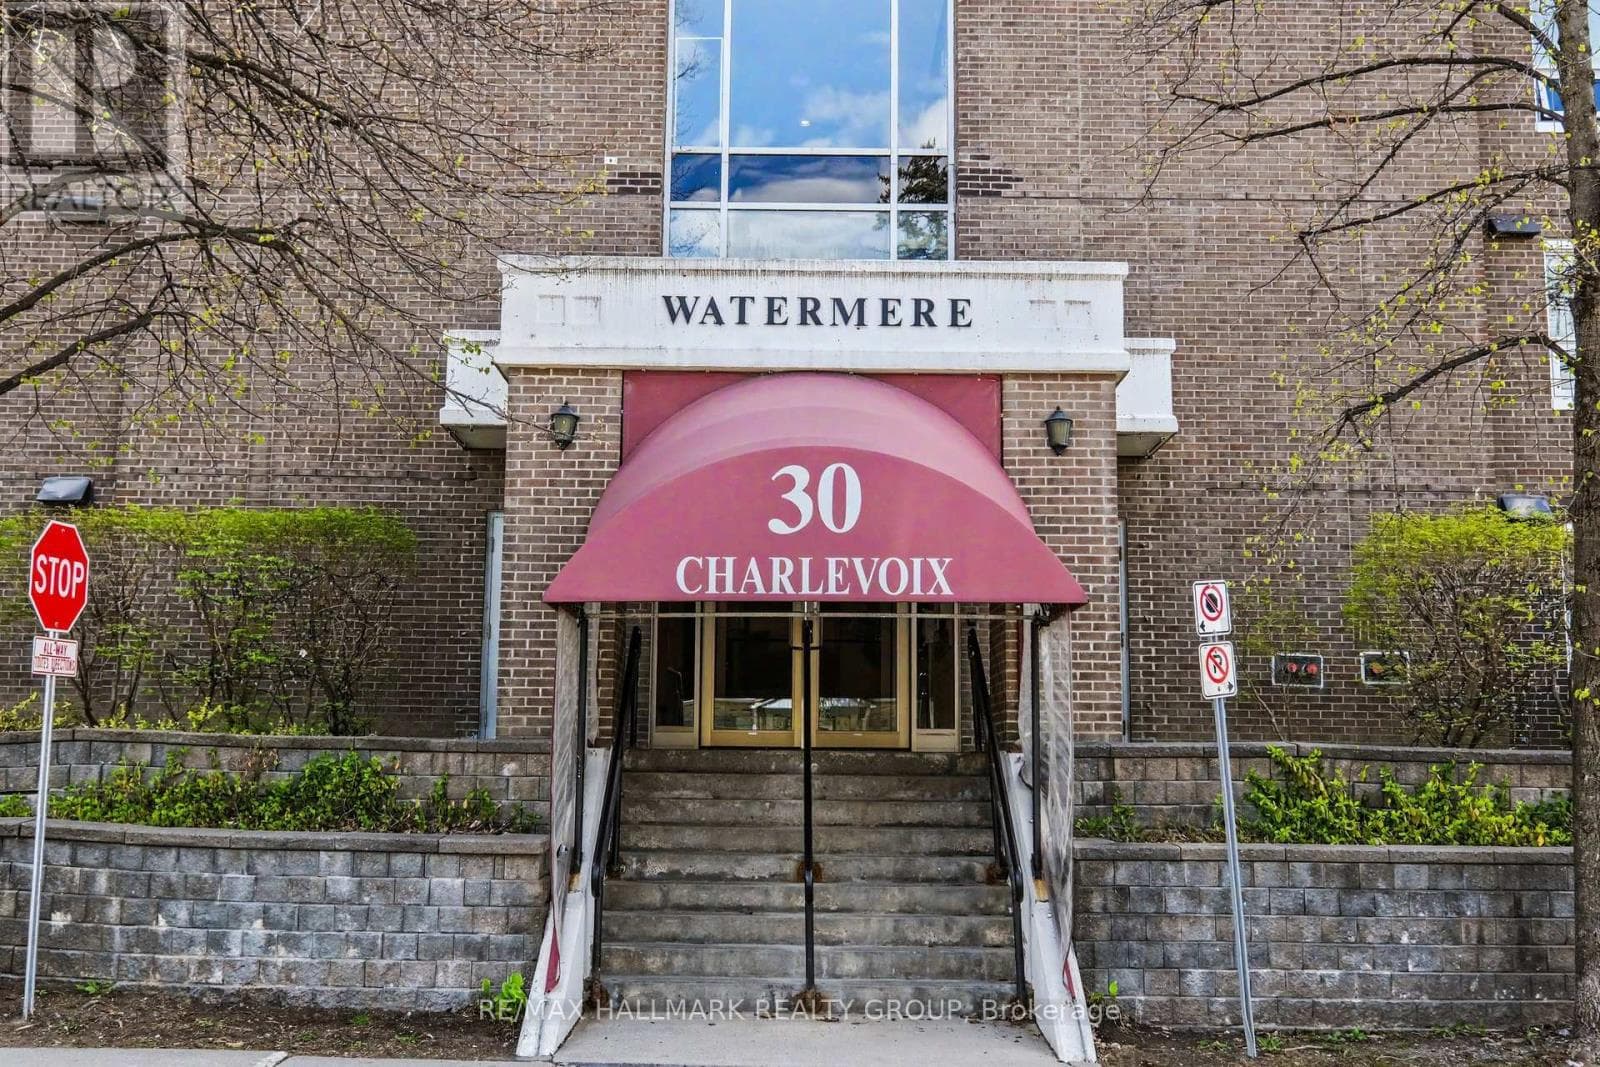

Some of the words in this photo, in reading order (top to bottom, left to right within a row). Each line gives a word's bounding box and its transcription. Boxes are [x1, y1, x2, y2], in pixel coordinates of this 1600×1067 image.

[661, 295, 973, 328] WATERMERE
[767, 462, 862, 535] 30
[34, 553, 85, 599] STOP
[675, 555, 954, 597] CHARLEVOIX
